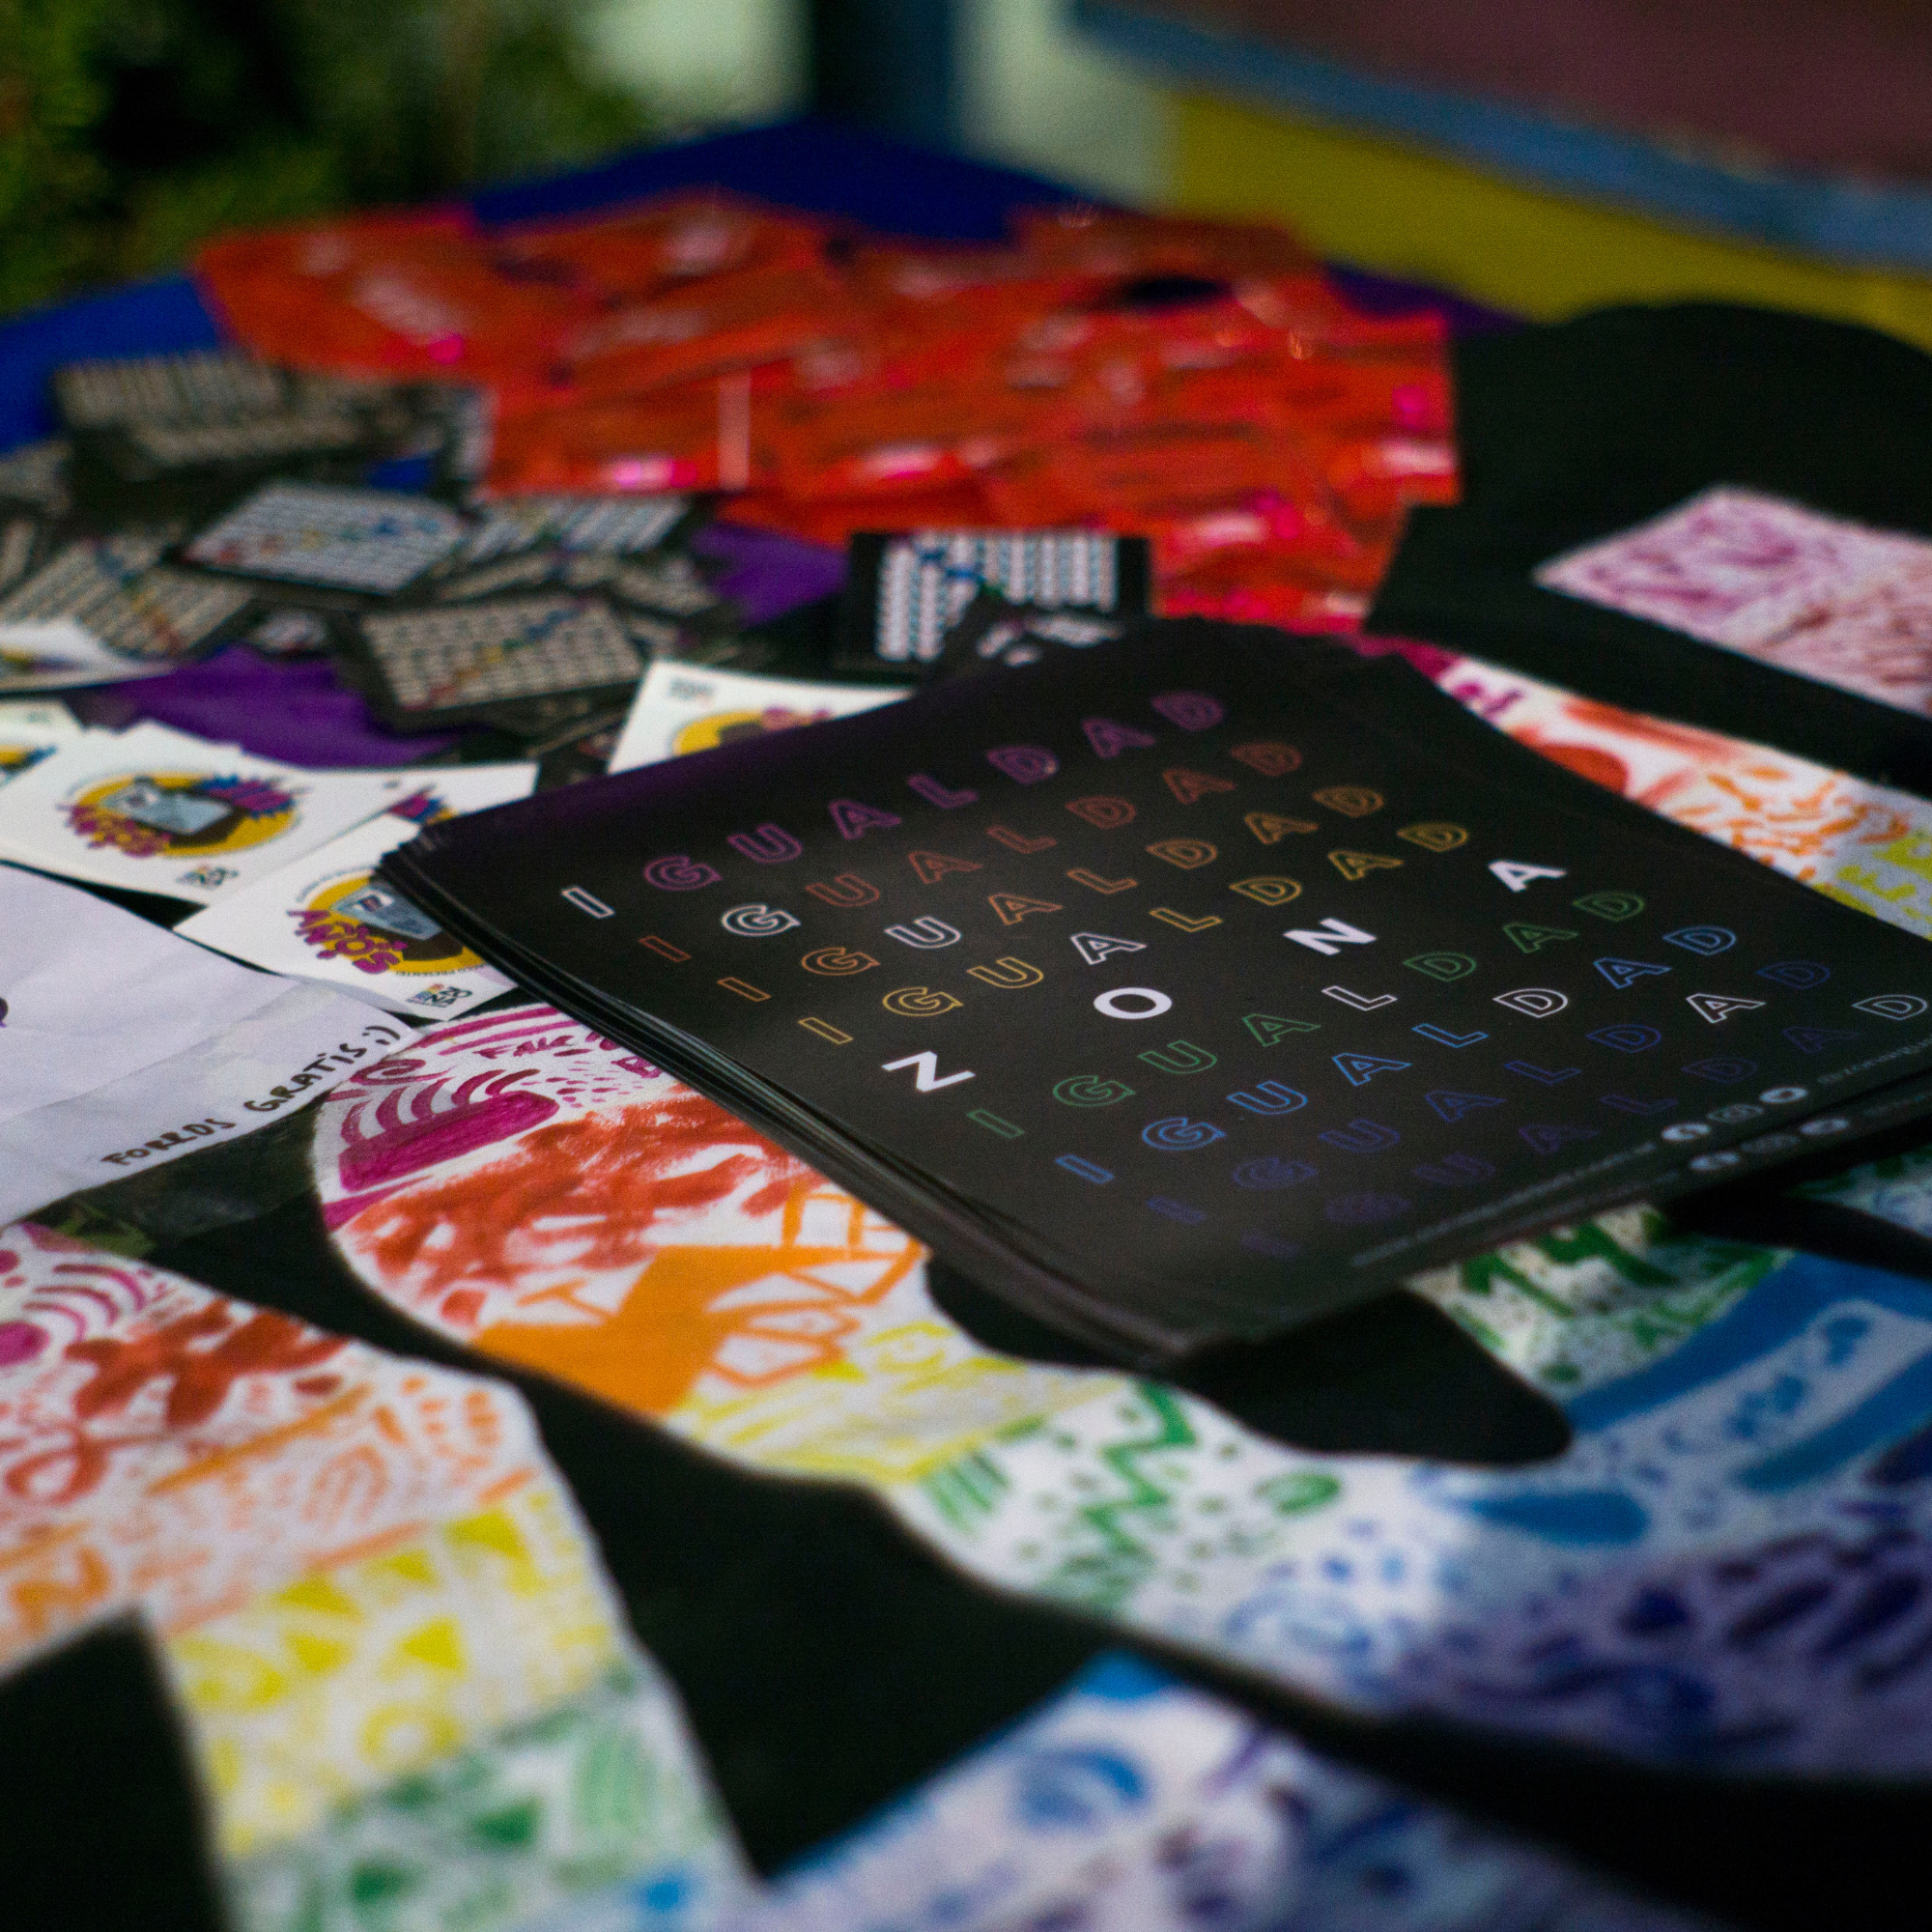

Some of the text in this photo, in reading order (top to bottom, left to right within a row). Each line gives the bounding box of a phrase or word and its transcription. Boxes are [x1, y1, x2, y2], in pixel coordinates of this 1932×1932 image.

[561, 691, 1224, 919] IGUALDAD
[639, 742, 1302, 962] IGUALDAD
[718, 785, 1384, 1002] IGUALDAD
[799, 822, 1468, 1044] IGUALDAD
[882, 860, 1567, 1092] ZONA
[967, 891, 1644, 1138] IGUALDAD
[1056, 925, 1736, 1184] IGUALDAD
